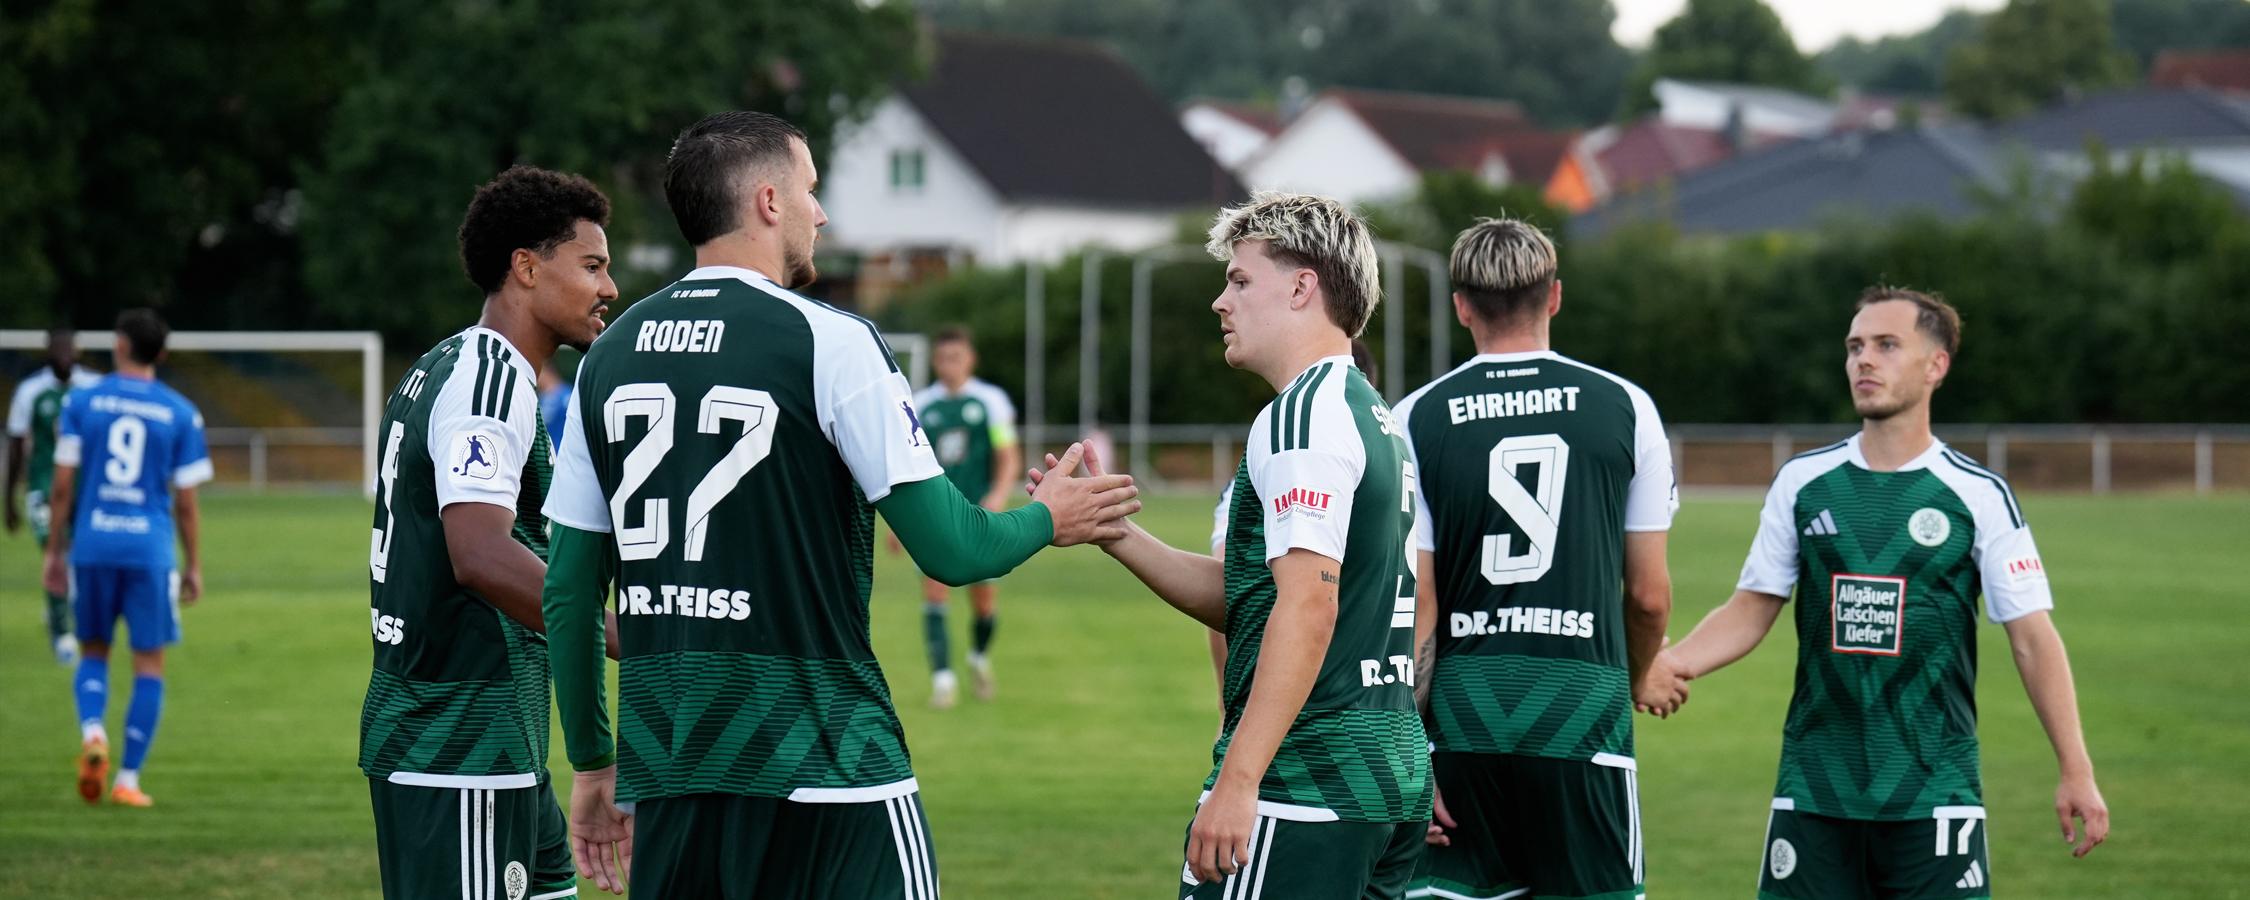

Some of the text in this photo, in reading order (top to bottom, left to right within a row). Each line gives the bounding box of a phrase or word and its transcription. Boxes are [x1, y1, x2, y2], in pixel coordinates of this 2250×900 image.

[635, 320, 725, 353] RODEN
[1448, 386, 1580, 425] EHRHART
[105, 415, 147, 487] 9
[603, 383, 780, 561] 27
[1480, 433, 1570, 585] 9
[1836, 603, 1896, 625] Latschen
[1839, 584, 1897, 607] Allgäuer
[1450, 607, 1594, 638] DR.THEISS
[1935, 818, 1977, 856] 17
